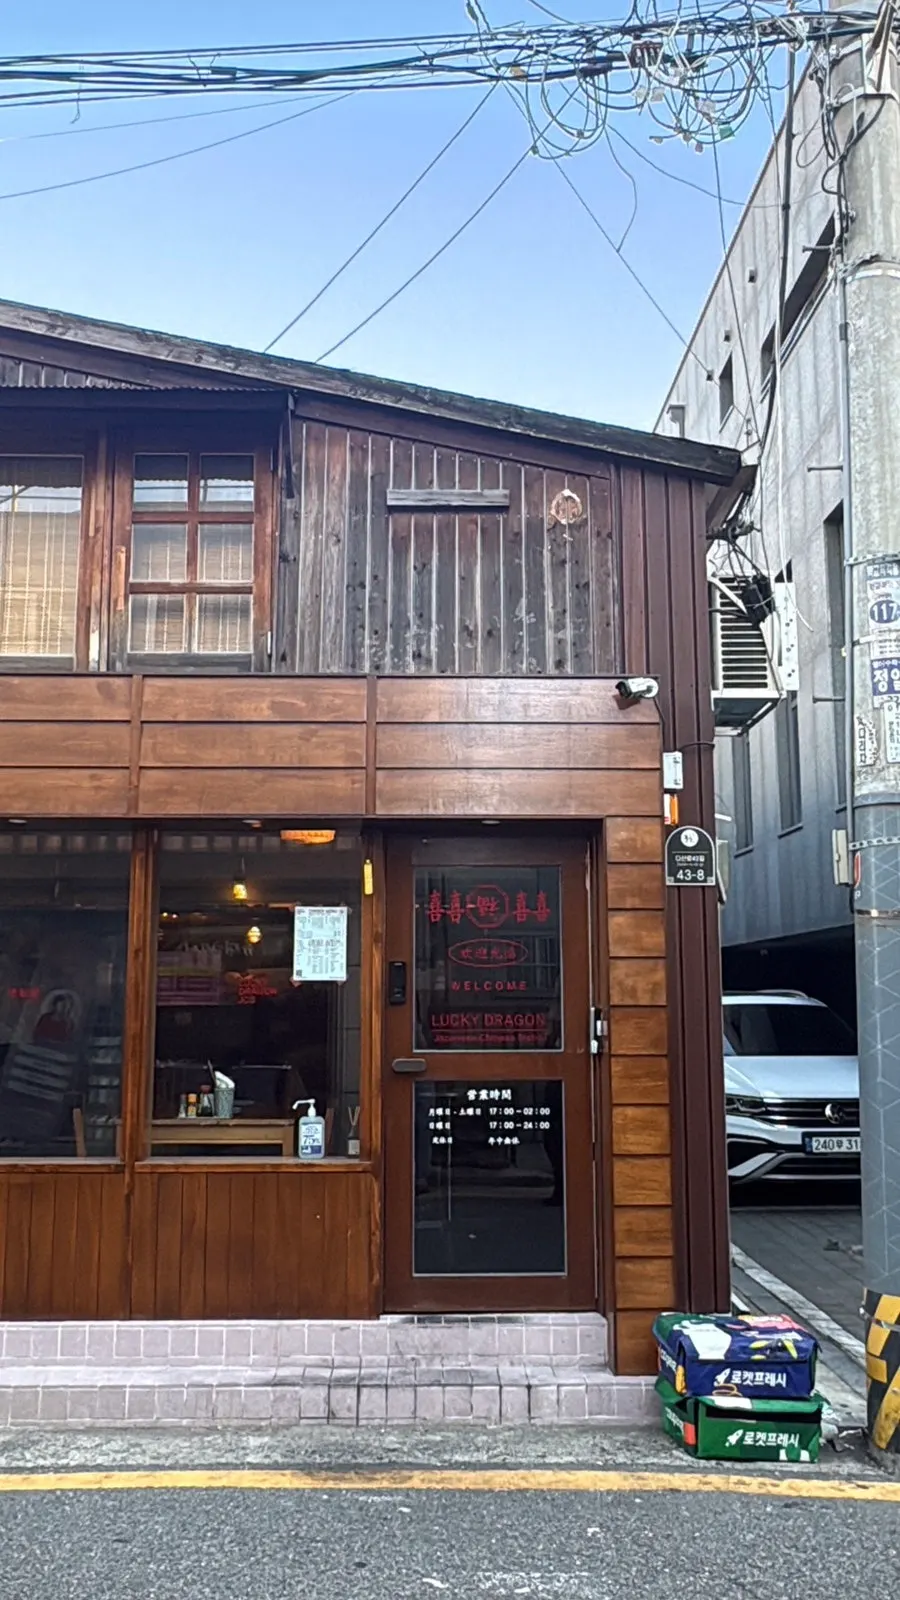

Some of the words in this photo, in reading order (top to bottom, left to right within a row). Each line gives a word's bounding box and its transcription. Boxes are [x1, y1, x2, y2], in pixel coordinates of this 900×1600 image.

[873, 603, 897, 621] 117
[676, 869, 705, 880] 43-8
[451, 981, 527, 991] WELCOME
[431, 1013, 480, 1027] LUCKY
[484, 1013, 547, 1027] DRAGON
[730, 1370, 787, 1388] 로켓프레시
[742, 1431, 800, 1448] 로켓프레시
